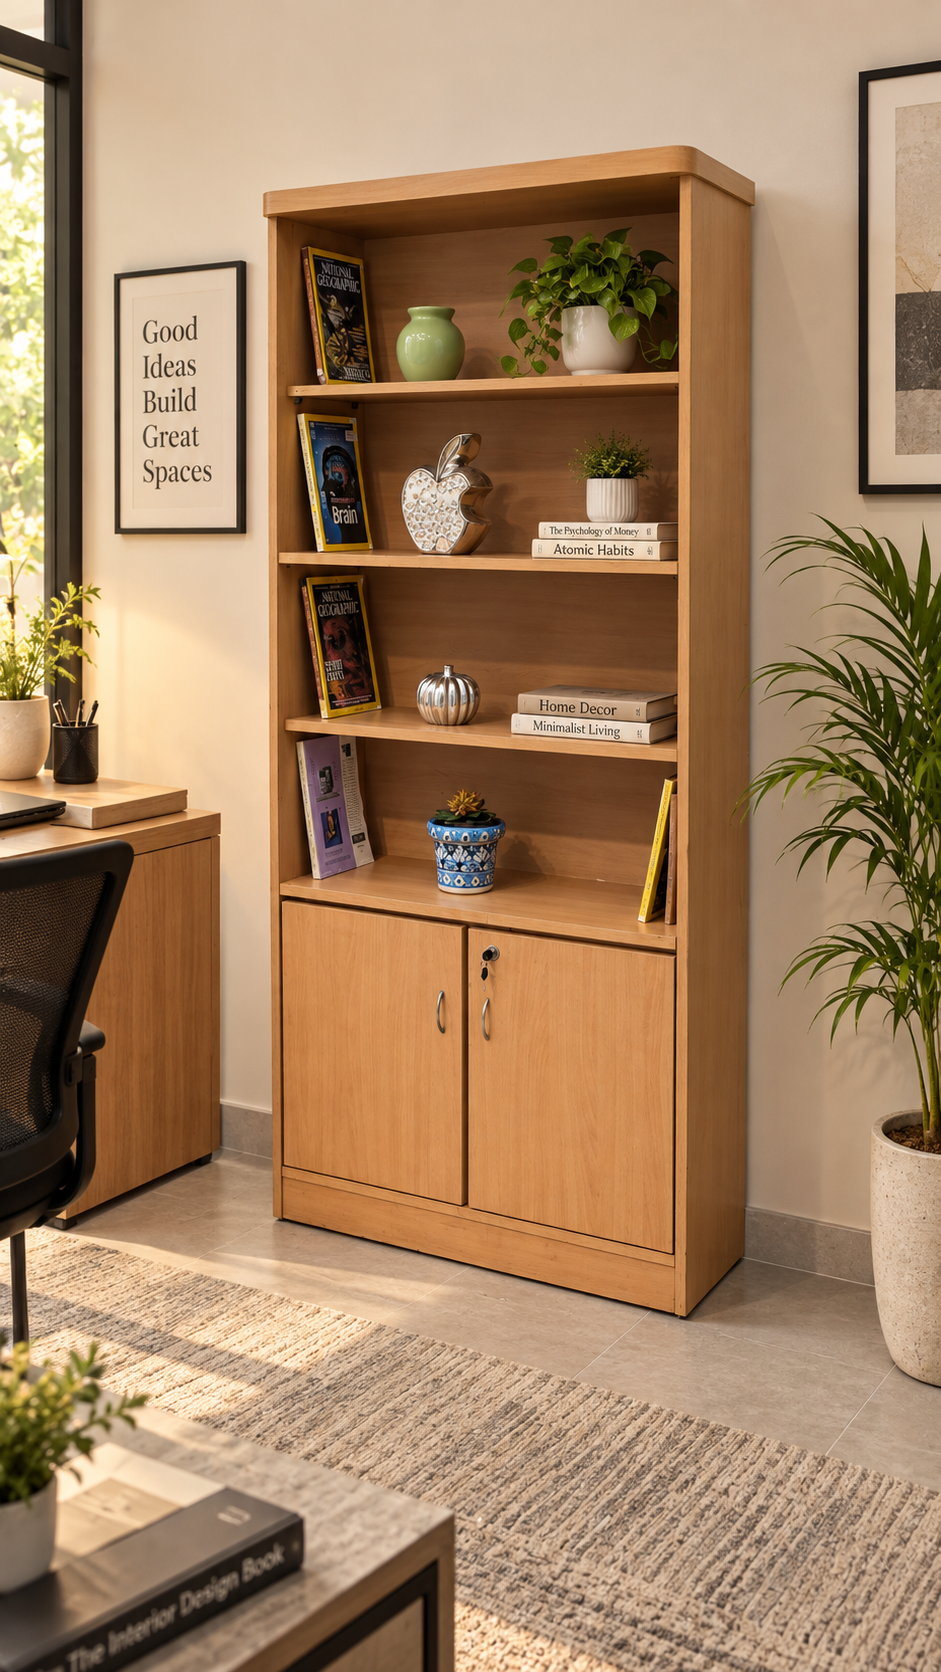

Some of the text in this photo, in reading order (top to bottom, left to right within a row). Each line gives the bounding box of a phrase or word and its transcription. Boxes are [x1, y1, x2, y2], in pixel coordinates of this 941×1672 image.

[142, 315, 199, 344] Good
[142, 353, 197, 379] Ideas
[142, 386, 197, 414] Build
[142, 424, 200, 449] Great
[142, 458, 213, 490] Spaces
[331, 504, 359, 525] Brain
[549, 526, 563, 535] The
[564, 526, 604, 538] Psychology
[604, 526, 613, 535] of
[614, 527, 640, 538] Money
[553, 543, 594, 556] Atomic
[597, 544, 635, 556] Habits
[539, 699, 576, 713] Home
[580, 701, 618, 716] Decor
[533, 719, 586, 735] Minimalist
[588, 723, 621, 740] Living
[65, 1542, 286, 1672] The Interior Design Book
